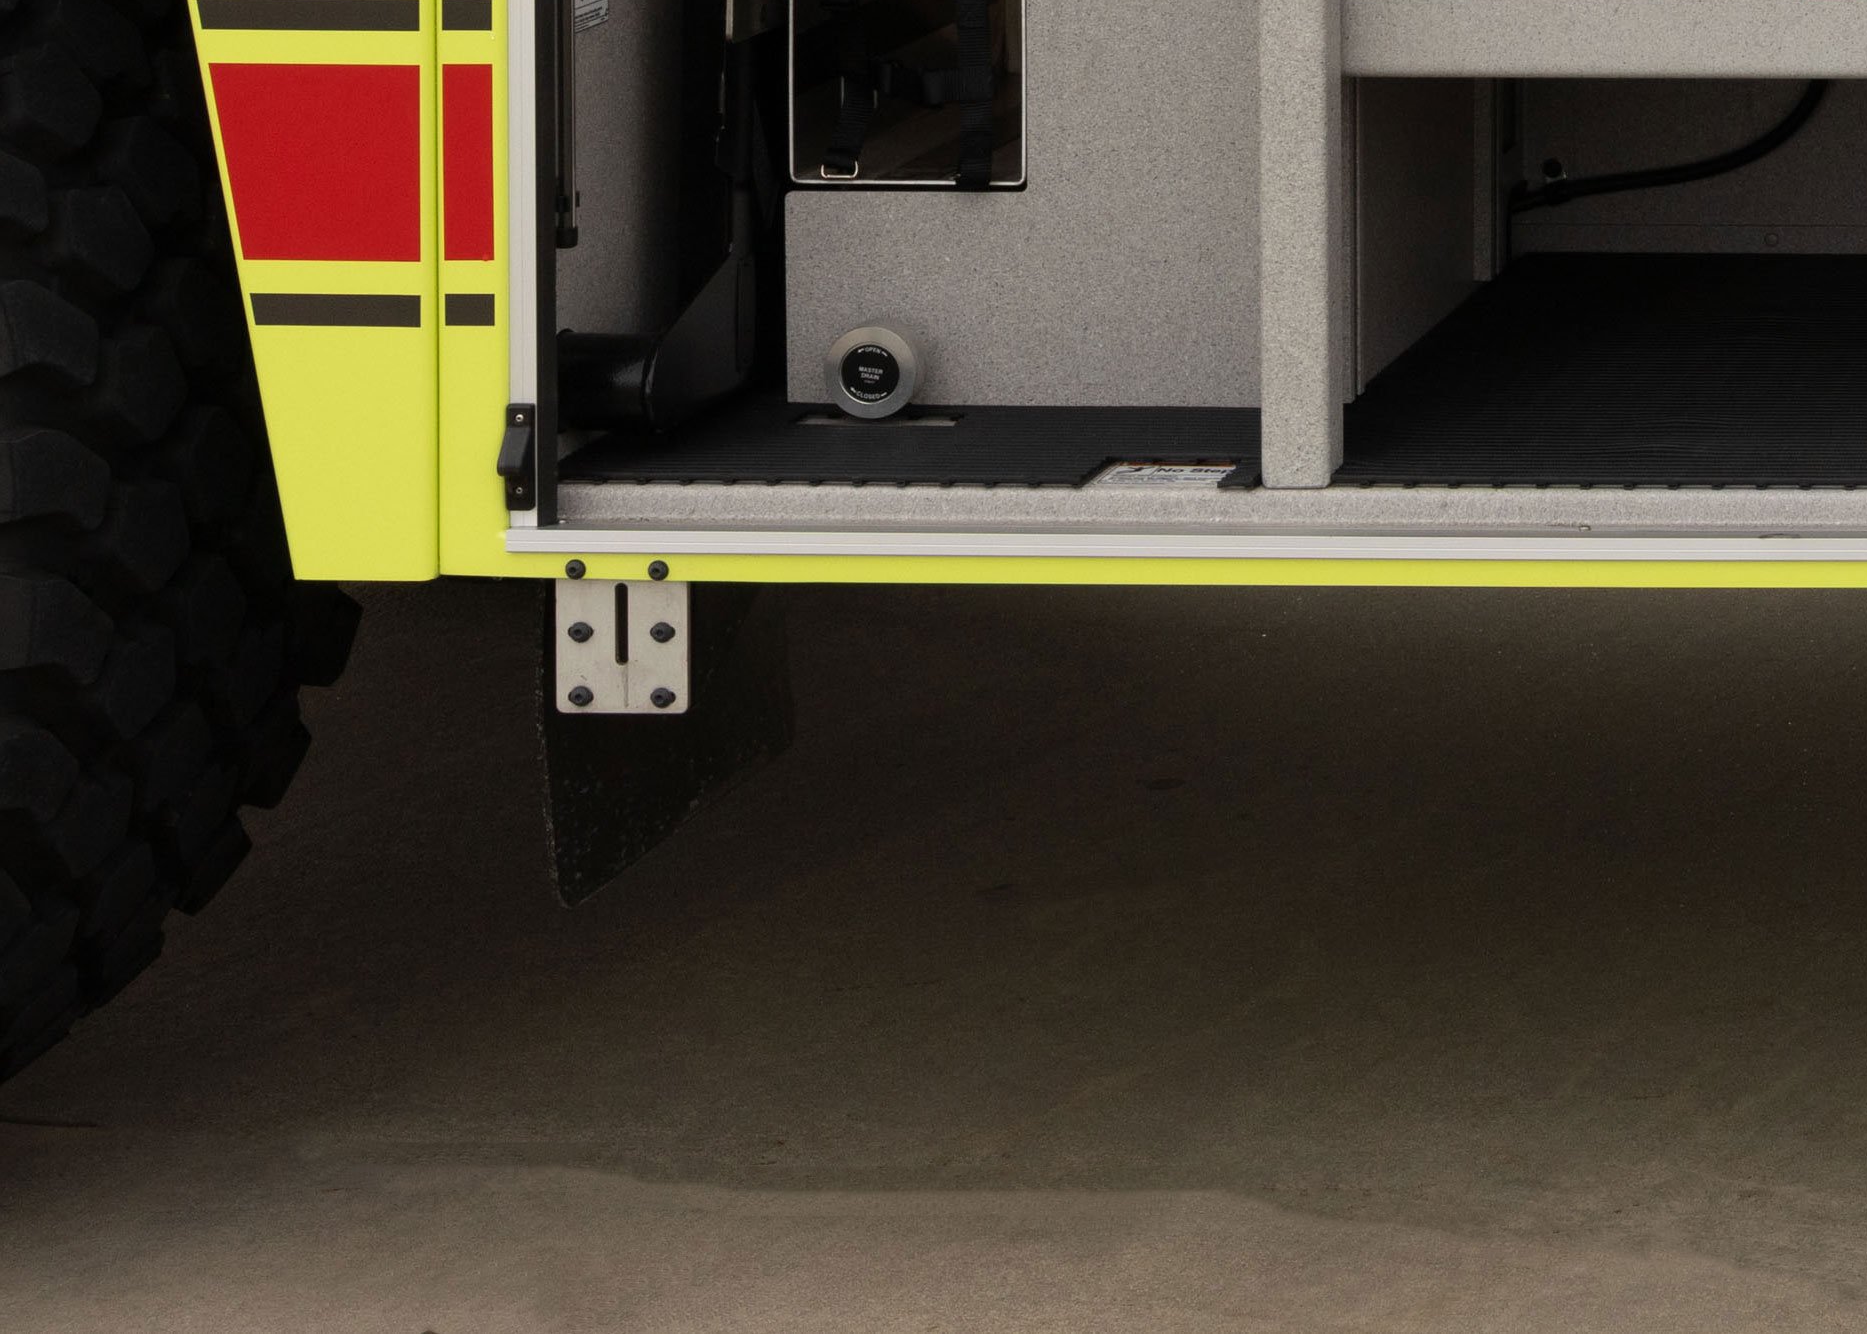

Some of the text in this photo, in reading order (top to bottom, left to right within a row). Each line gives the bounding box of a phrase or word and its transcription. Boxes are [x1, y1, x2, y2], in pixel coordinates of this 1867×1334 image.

[864, 346, 881, 354] OPEN
[858, 366, 884, 375] MASTER
[856, 391, 881, 400] CLOSED
